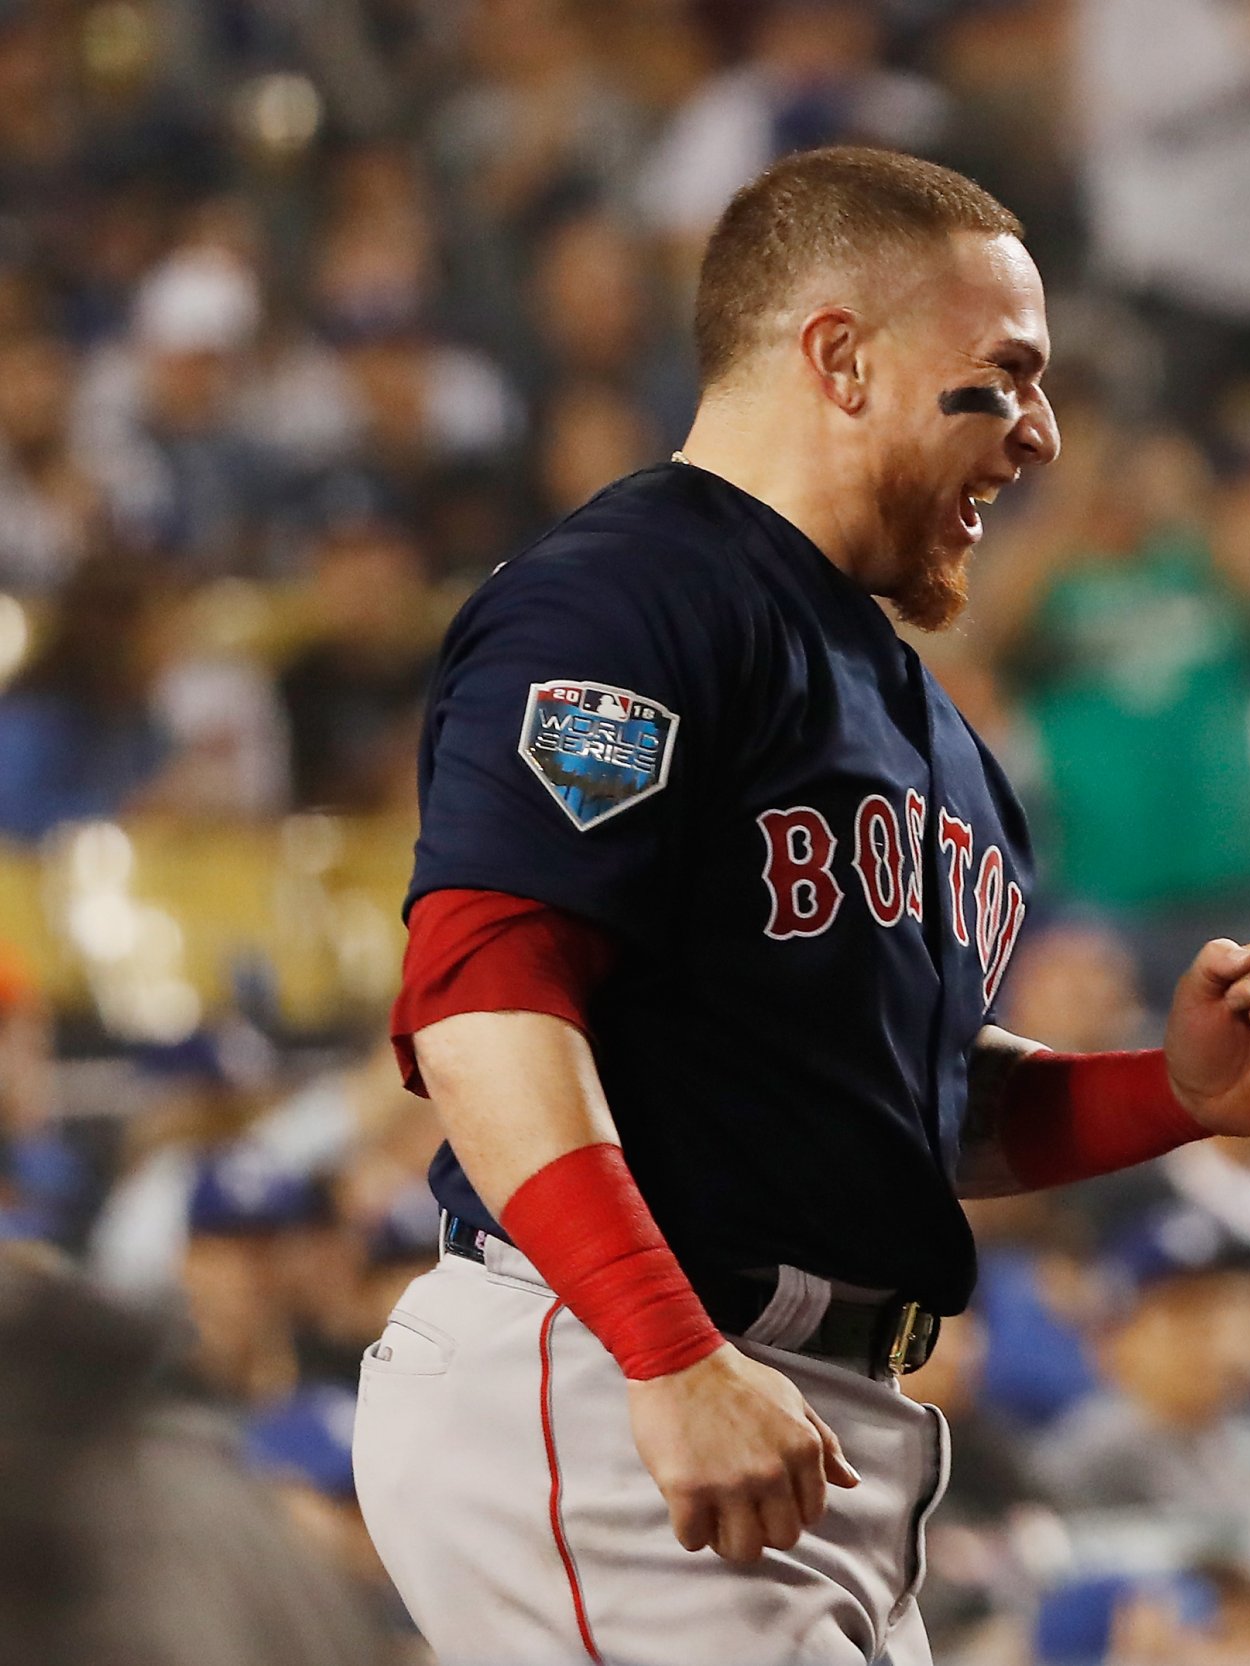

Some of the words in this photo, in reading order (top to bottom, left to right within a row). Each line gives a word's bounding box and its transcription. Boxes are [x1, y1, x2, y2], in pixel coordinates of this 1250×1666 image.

[552, 689, 579, 702] 20
[539, 710, 660, 753] WORLD
[535, 733, 657, 774] SERIES
